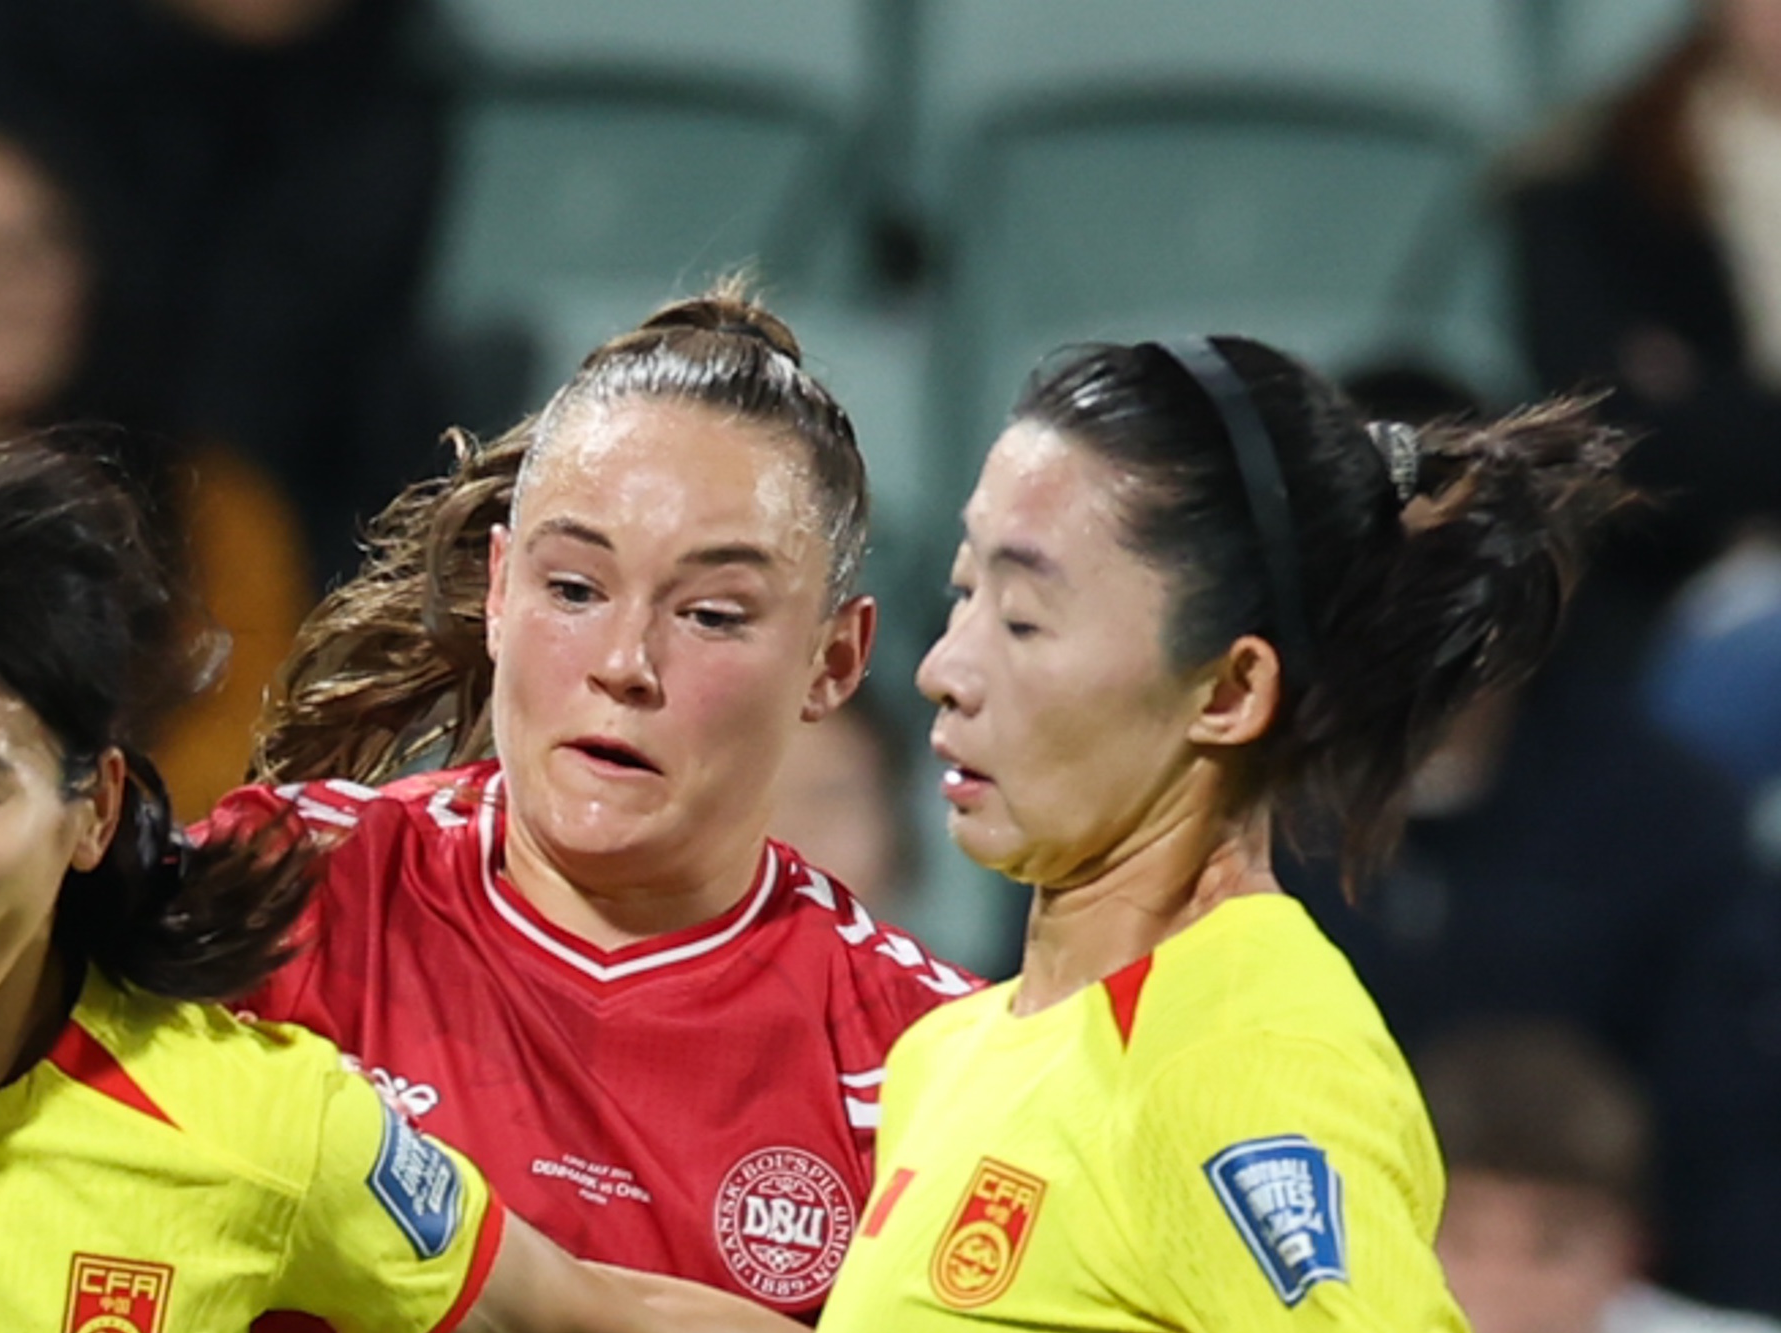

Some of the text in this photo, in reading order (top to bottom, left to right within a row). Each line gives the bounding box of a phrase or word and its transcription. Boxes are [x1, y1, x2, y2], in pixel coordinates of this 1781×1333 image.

[975, 1171, 1035, 1215] CFA
[719, 1183, 747, 1270] DANSK
[811, 1205, 851, 1284] UNION
[742, 1195, 825, 1248] DBU
[79, 1266, 159, 1301] CFA
[749, 1273, 807, 1297] 1889
